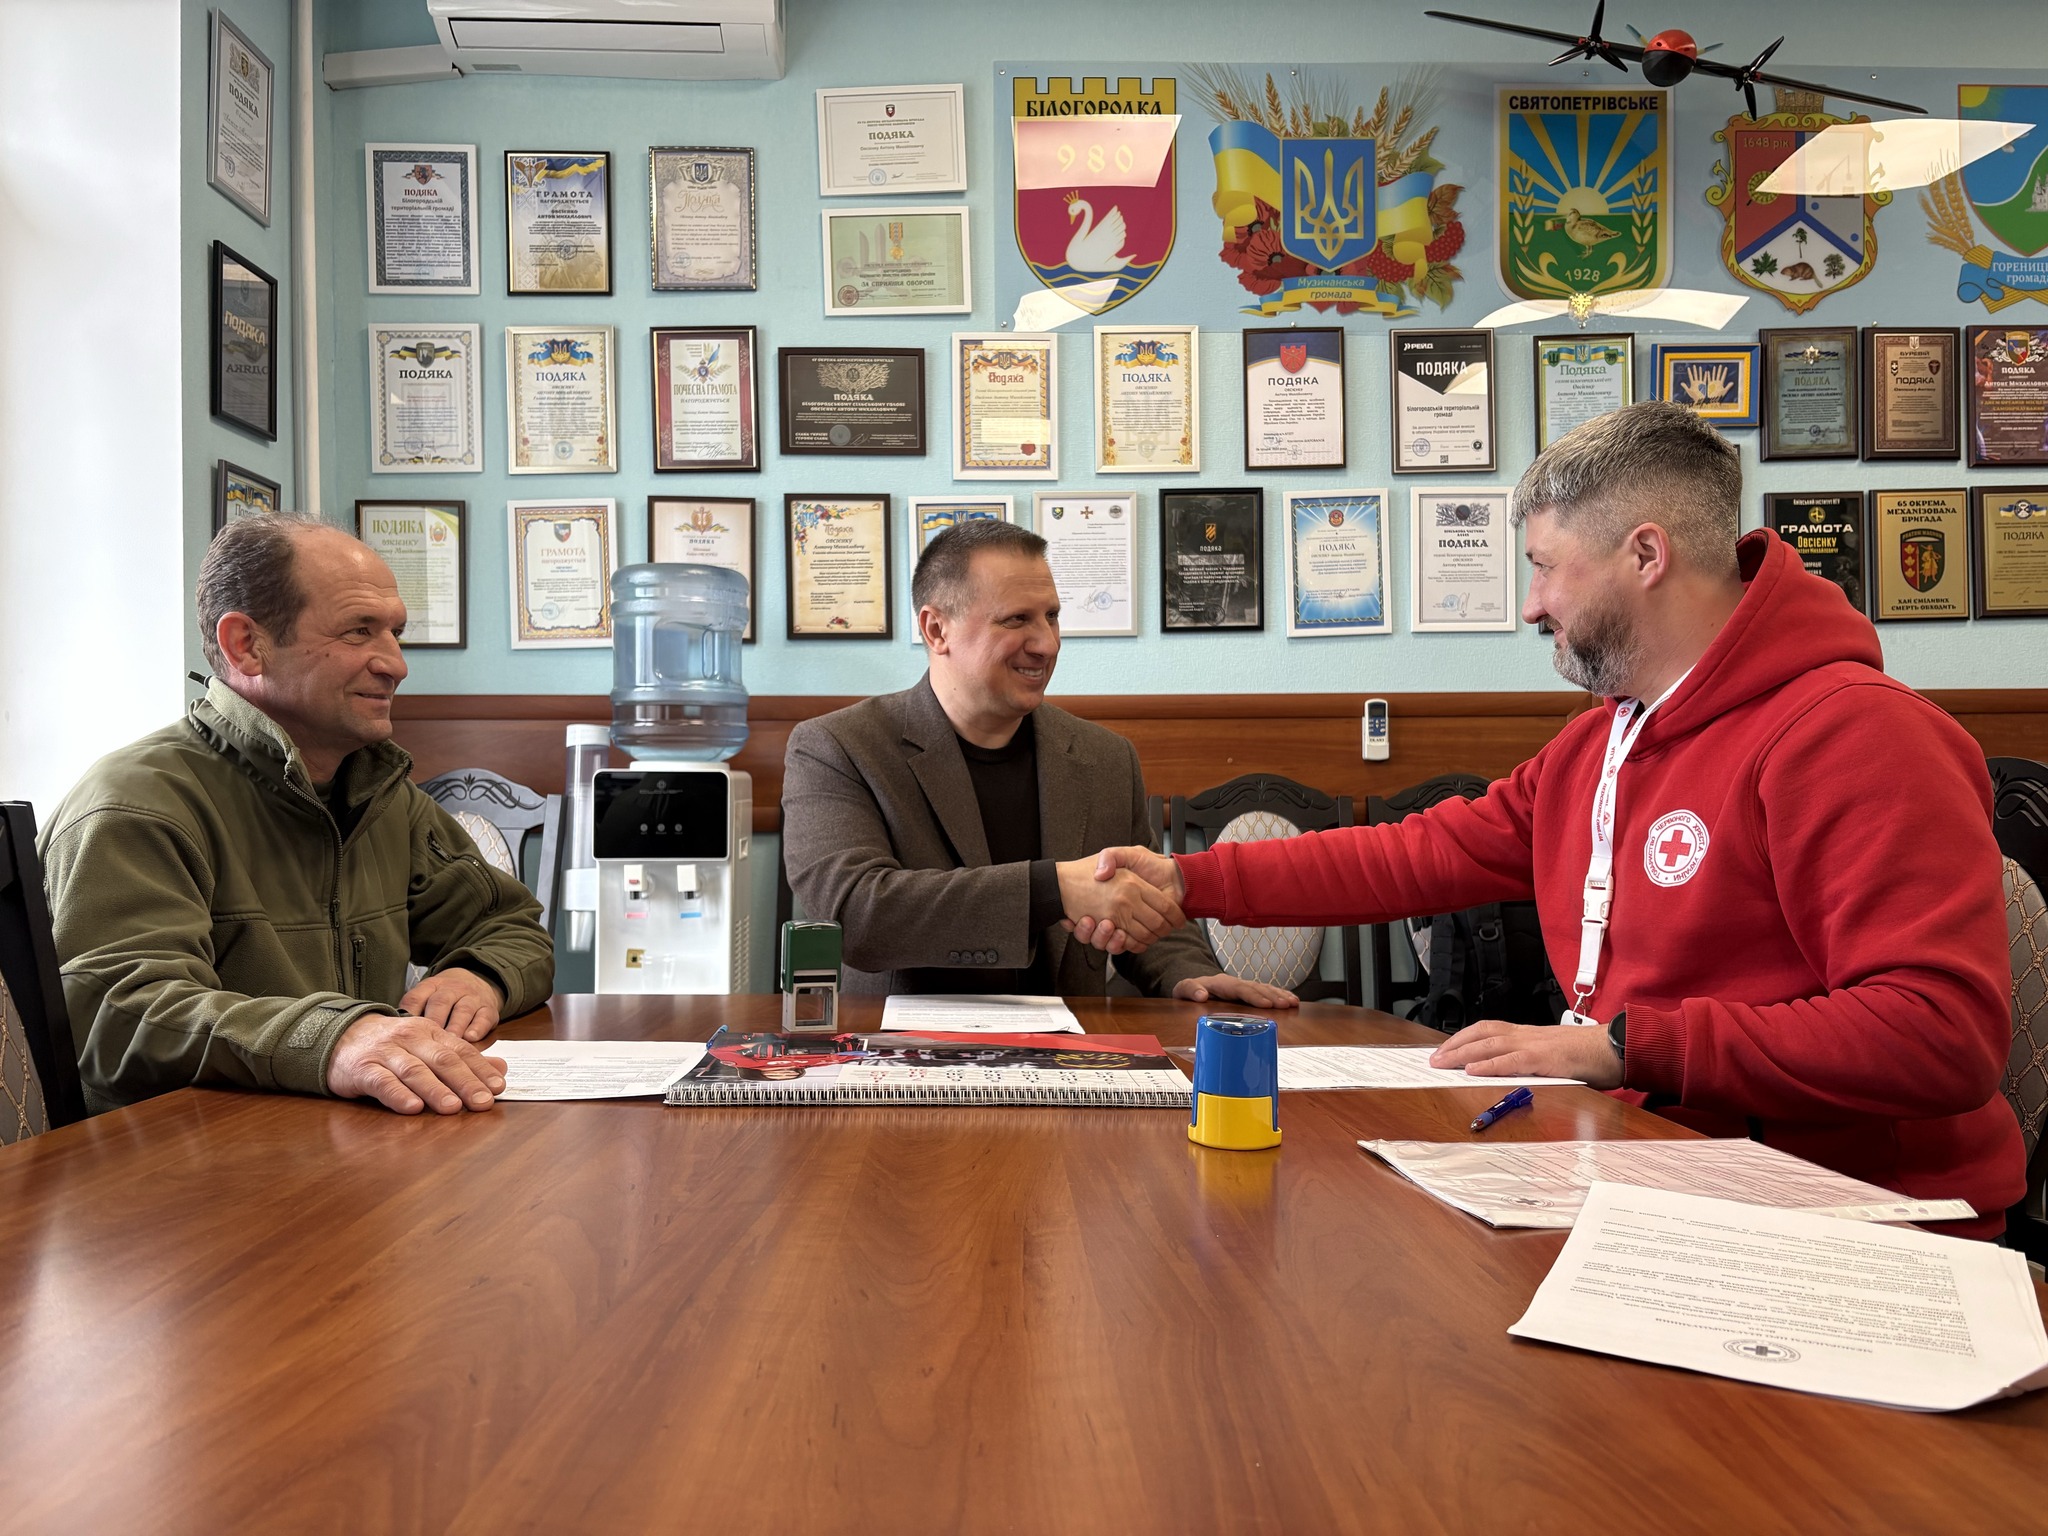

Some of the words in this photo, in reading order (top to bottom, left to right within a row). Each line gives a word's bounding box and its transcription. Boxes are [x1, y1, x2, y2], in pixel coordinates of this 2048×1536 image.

[229, 82, 259, 118] ПОДЯКА
[1509, 96, 1658, 110] СВЯТОПЕТРІВСЬКЕ
[868, 130, 915, 141] ПОДЯКА
[1743, 137, 1770, 148] 1648
[404, 189, 438, 197] ПОДЯКА
[1565, 268, 1600, 282] 1928
[1297, 278, 1365, 288] Музичанська
[1310, 291, 1352, 300] громада
[225, 310, 266, 347] ПОДЯКА
[1416, 361, 1468, 376] ПОДЯКА
[1560, 364, 1606, 376] Подяка
[2001, 366, 2036, 374] ПОДЯКА
[399, 369, 453, 380] ПОДЯКА
[536, 371, 586, 382] ПОДЯКА
[988, 372, 1024, 386] Подяка
[1122, 373, 1172, 383] ПОДЯКА
[1268, 377, 1319, 387] ПОДЯКА
[1896, 377, 1935, 385] ПОДЯКА
[673, 384, 706, 395] ПОЧЕСНА
[707, 384, 738, 395] ГРАМОТА
[833, 393, 874, 401] ПОДЯКА
[1909, 499, 1946, 507] ОКРЕМА
[1887, 507, 1957, 515] МЕХАНІЗОВАНА
[372, 519, 424, 535] ПОДЯКА
[1780, 523, 1854, 534] ГРАМОТА
[2003, 531, 2045, 541] ПОДЯКА
[1319, 543, 1356, 552] ПОДЯКА
[1438, 539, 1489, 549] ПОДЯКА
[541, 548, 586, 557] ГРАМОТА
[1655, 815, 1691, 831] ЧЕРВОНОГО
[1692, 823, 1705, 852] ХРЕСТА
[1673, 857, 1699, 882] УКРАЇНИ
